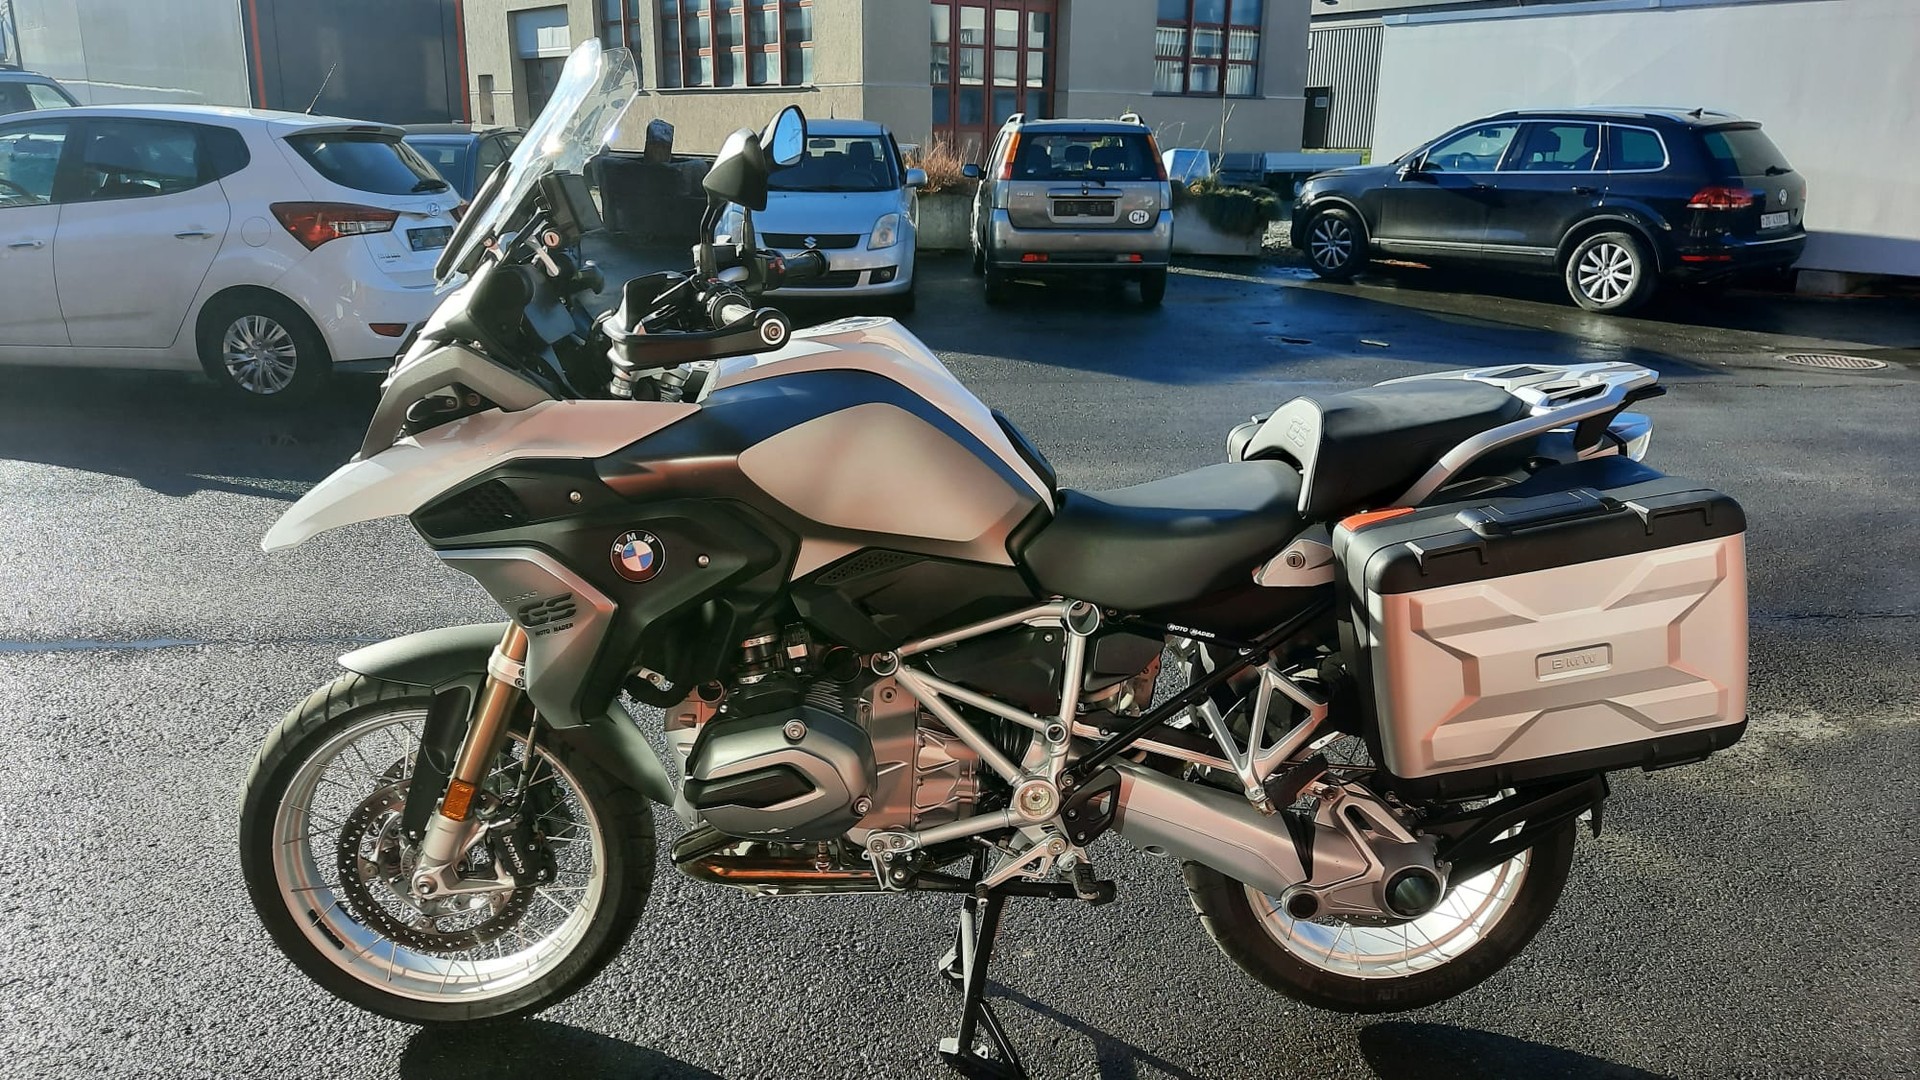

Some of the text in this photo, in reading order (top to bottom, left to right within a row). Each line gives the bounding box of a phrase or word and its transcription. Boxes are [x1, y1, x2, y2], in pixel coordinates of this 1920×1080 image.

[1131, 213, 1146, 222] CH
[614, 532, 655, 553] BMW
[518, 592, 577, 627] GS
[1551, 653, 1598, 670] BMW
[502, 835, 525, 874] brembo
